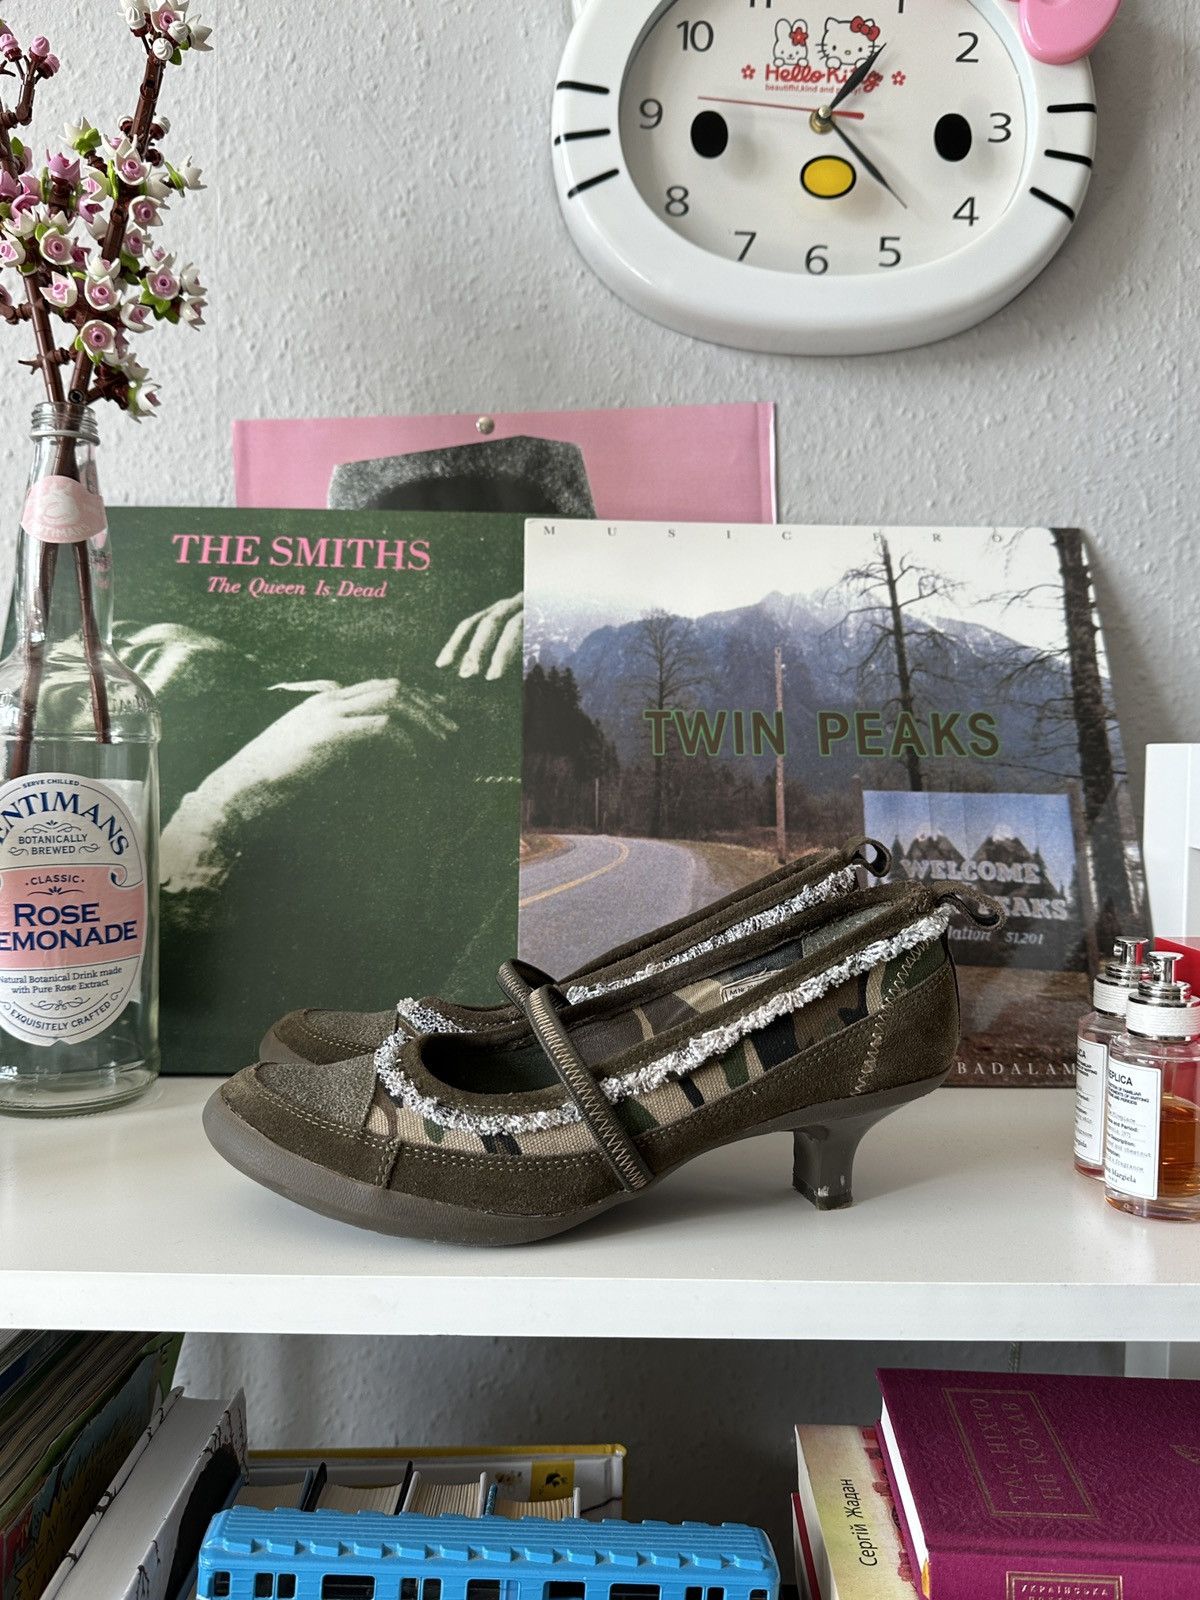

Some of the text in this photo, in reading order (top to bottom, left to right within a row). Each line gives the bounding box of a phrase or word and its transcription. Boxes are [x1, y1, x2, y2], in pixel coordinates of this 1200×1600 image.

[677, 20, 714, 52] 10
[956, 32, 980, 63] 2
[765, 64, 884, 93] Hello Kiy
[639, 98, 663, 129] 9
[988, 112, 1012, 143] 3
[665, 185, 690, 217] 8
[952, 197, 980, 227] 4
[734, 230, 757, 262] 7
[805, 245, 829, 275] 6
[879, 236, 902, 268] 5
[172, 534, 431, 571] THE SMITHS
[207, 576, 388, 598] The Queen Is Dead
[643, 709, 1001, 758] TWIN PEAKS
[22, 778, 80, 788] SERVE CHILLED
[18, 834, 88, 844] BOTANICALLY
[31, 846, 76, 855] BREWED
[30, 874, 80, 885] CLASSIC
[901, 859, 1040, 884] WELCOME
[14, 902, 100, 927] ROSE
[979, 895, 1068, 920] EAKS
[0, 920, 137, 951] EMONADE
[949, 925, 992, 942] lation
[11, 979, 109, 994] with Pure Rose Extract
[29, 973, 70, 983] Botanical
[73, 970, 98, 980] Drink
[100, 966, 122, 977] made
[10, 1001, 111, 1031] EXQUISITELY CRAFTED
[957, 1062, 1076, 1075] BADALAM
[1108, 1069, 1133, 1087] EPLICA
[970, 1398, 1030, 1504] ТАК НІХТО
[1002, 1402, 1066, 1501] НЕ КОХАВ
[840, 1478, 878, 1567] Сергій Жадан
